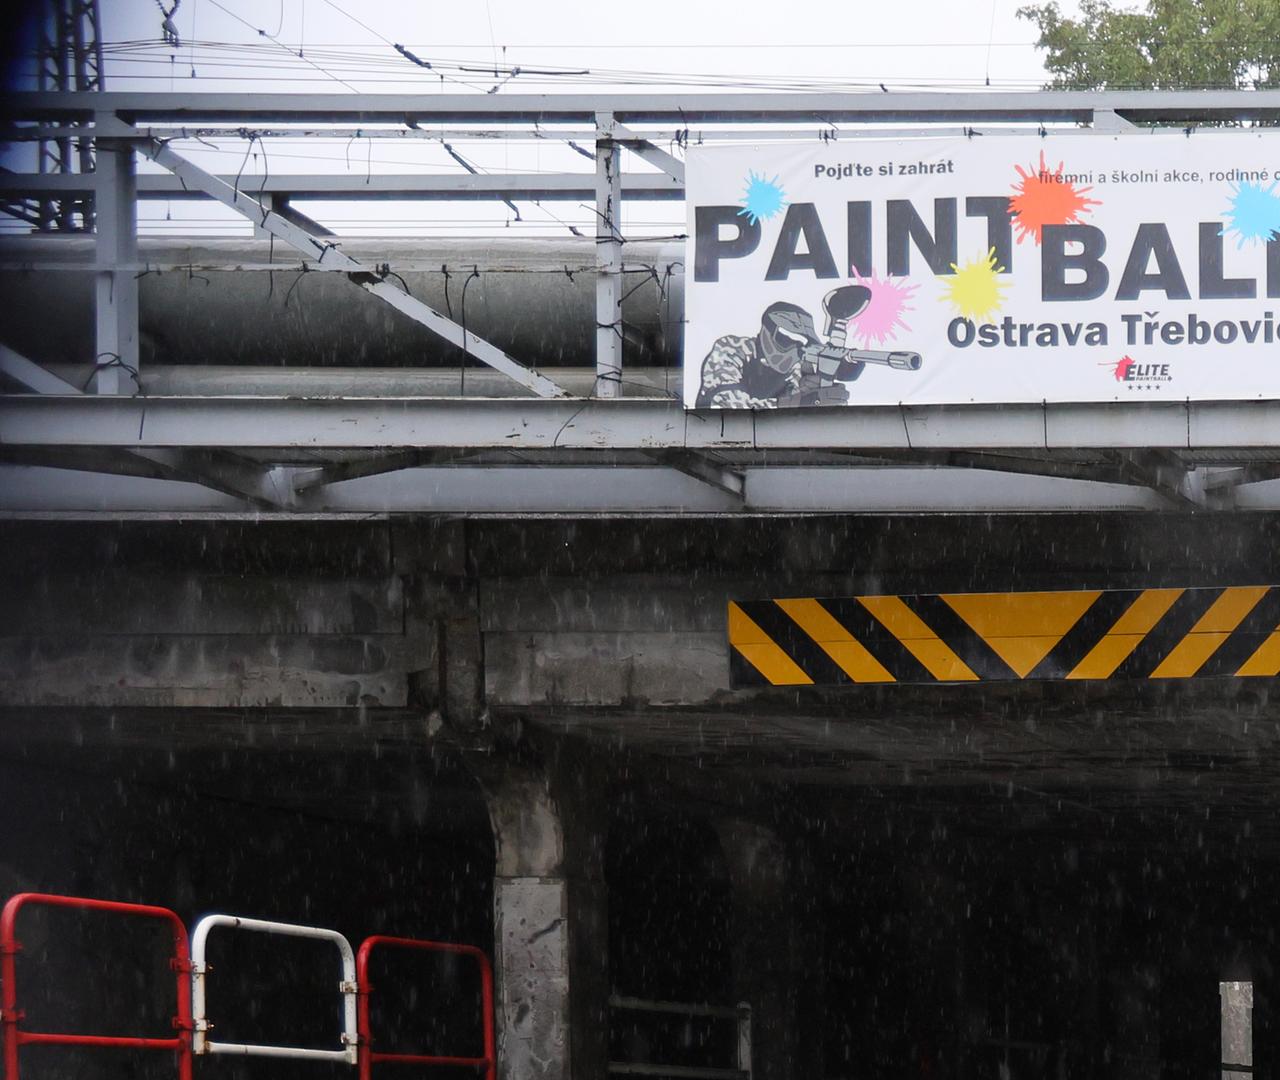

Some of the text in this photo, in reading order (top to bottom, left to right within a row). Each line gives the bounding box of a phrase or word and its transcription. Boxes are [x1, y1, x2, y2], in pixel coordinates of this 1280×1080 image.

[814, 160, 954, 180] Pojďte si zahrát
[1098, 175, 1107, 184] a
[1163, 169, 1204, 184] akce,
[1209, 167, 1269, 182] rodinné
[694, 196, 1019, 283] PAINT
[947, 316, 1109, 348] Ostrava
[1124, 364, 1170, 381] ELITE
